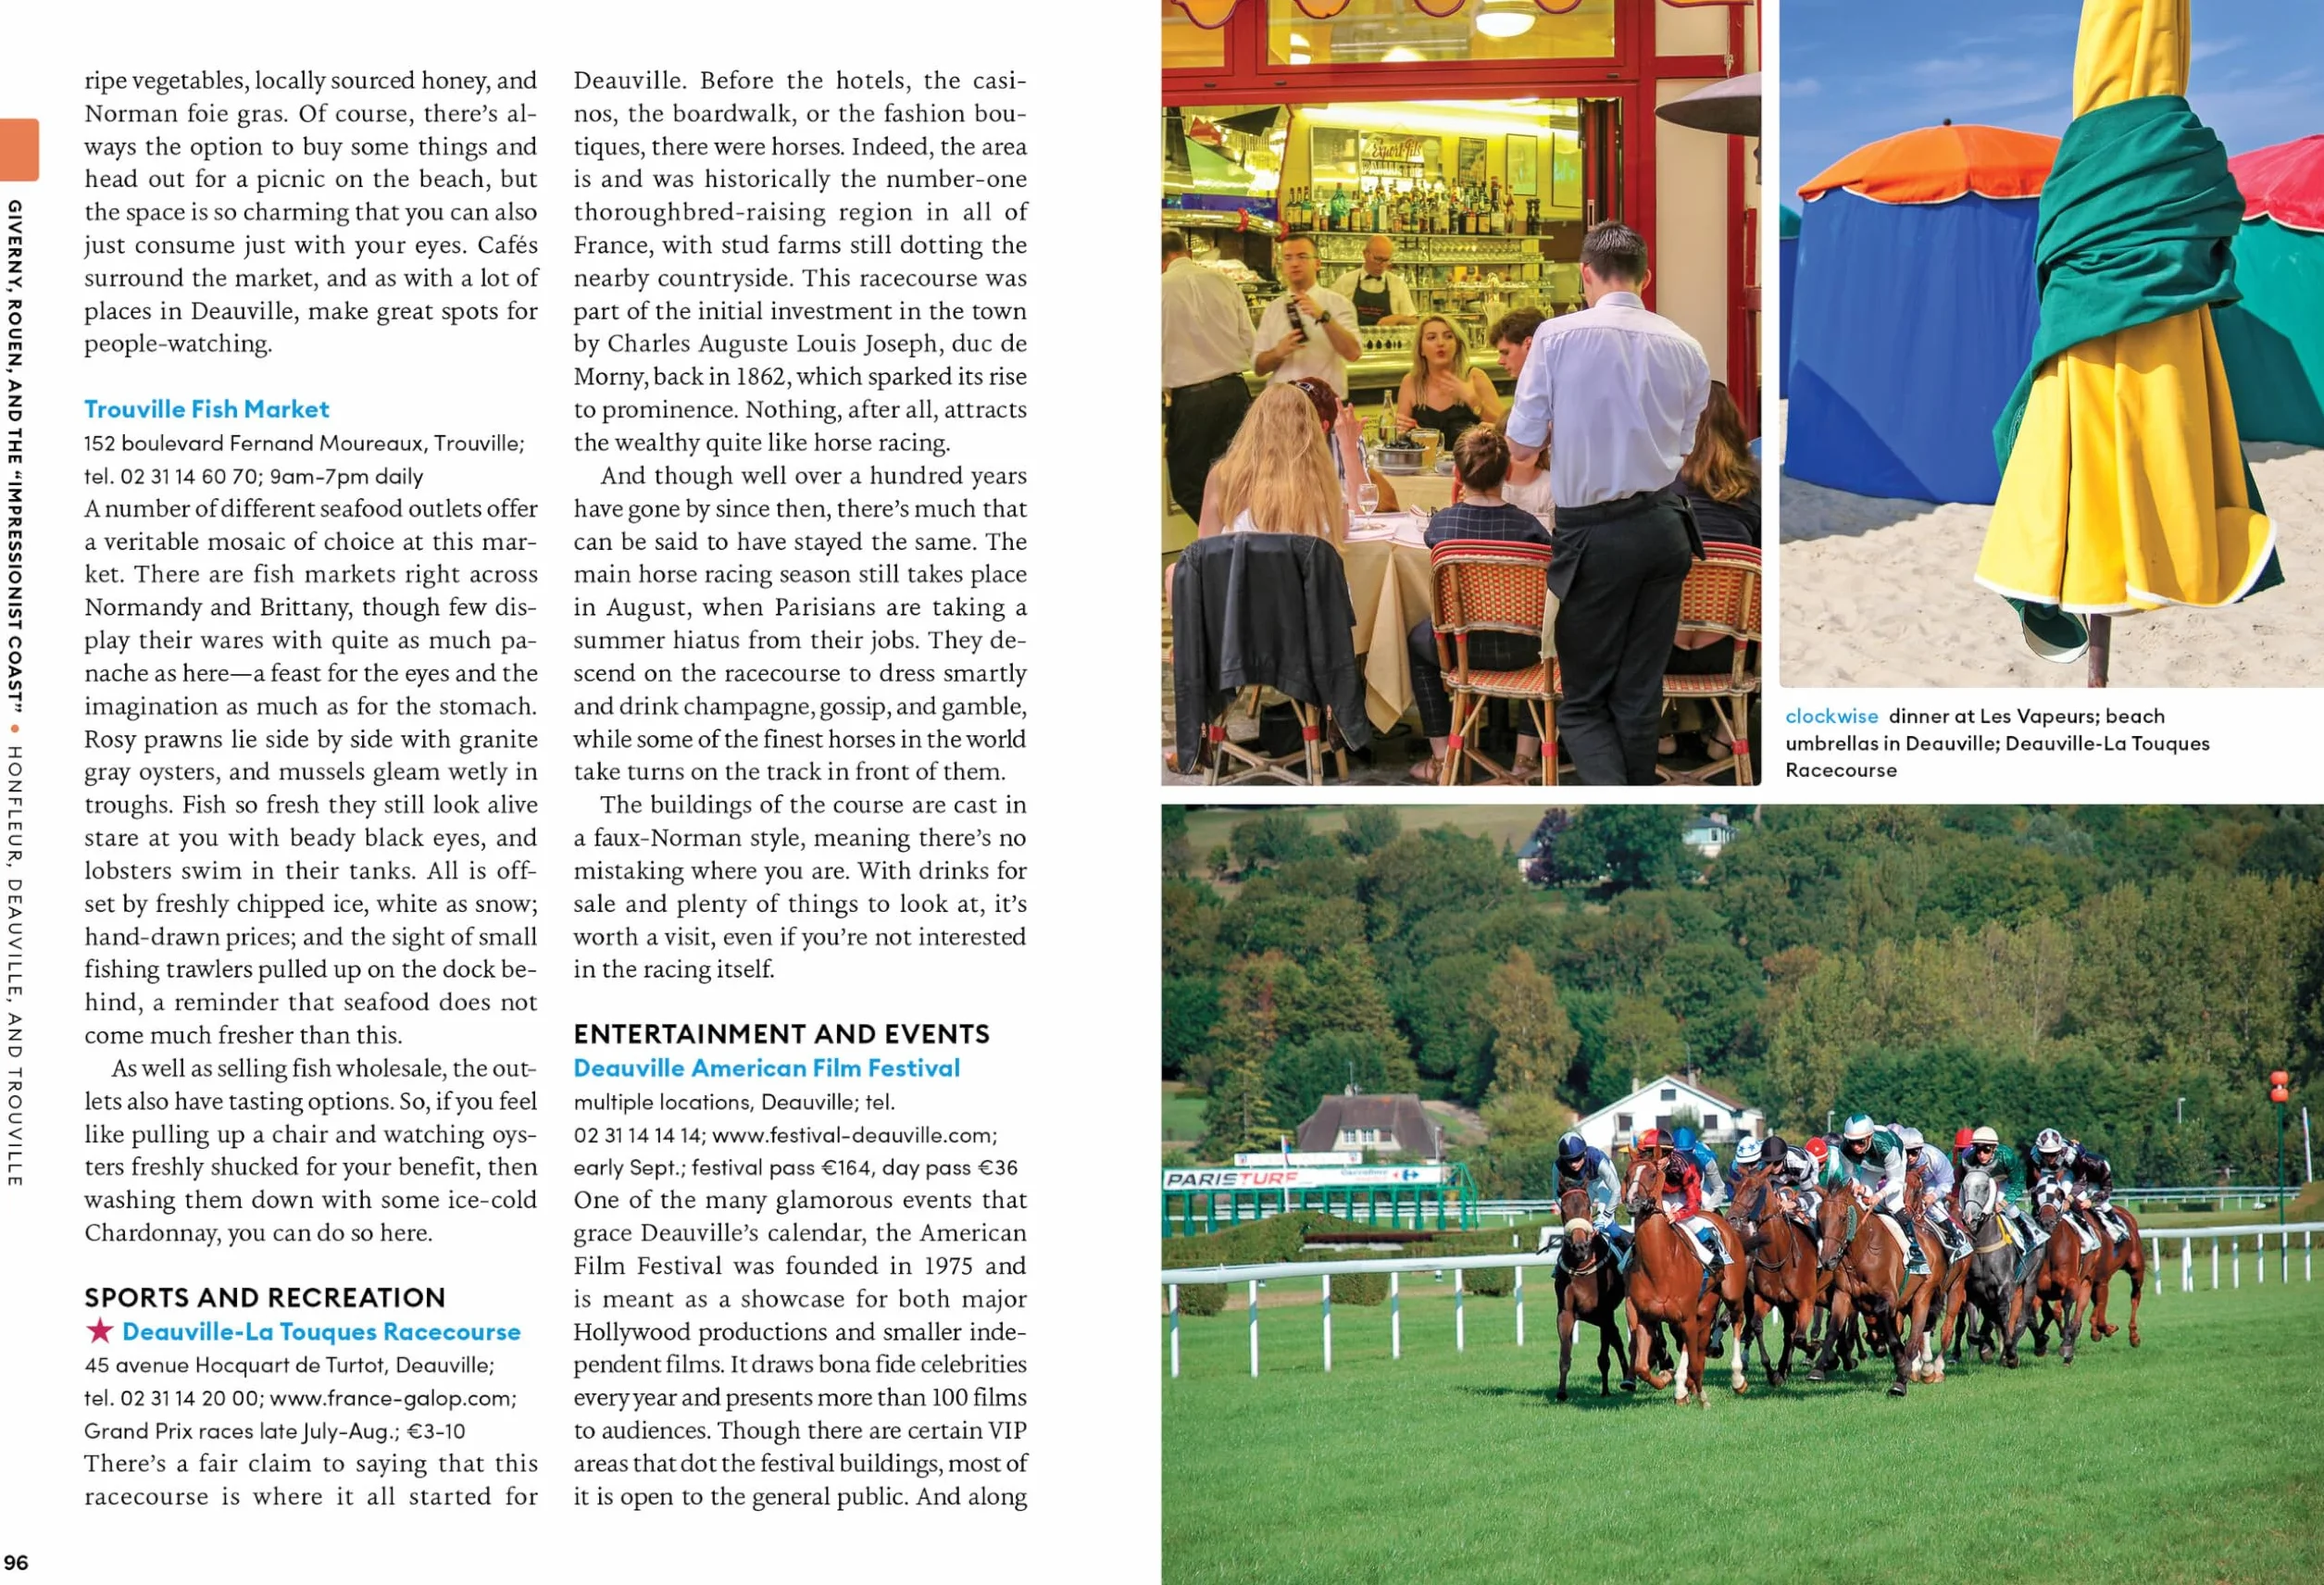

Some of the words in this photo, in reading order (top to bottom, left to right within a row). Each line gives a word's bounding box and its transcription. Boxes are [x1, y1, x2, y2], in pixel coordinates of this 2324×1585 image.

[85, 70, 127, 94] ripe
[132, 70, 249, 95] vegetables,
[256, 70, 327, 94] locally
[331, 70, 415, 89] sourced
[422, 70, 491, 95] honey,
[497, 70, 537, 89] and
[574, 70, 686, 89] Deauville.
[701, 69, 773, 89] Before
[787, 70, 822, 89] the
[837, 70, 911, 94] hotels,
[925, 70, 960, 89] the
[974, 70, 1026, 89] casi-
[575, 202, 826, 227] thoroughbred-raising
[840, 202, 912, 227] region
[928, 202, 948, 220] in
[964, 202, 991, 220] all
[1006, 201, 1030, 220] of
[6, 200, 22, 293] GIVERNY,
[84, 301, 151, 325] places
[161, 301, 181, 319] in
[192, 301, 299, 324] Deauville,
[308, 301, 369, 319] make
[377, 305, 433, 326] great
[442, 305, 498, 325] spots
[507, 300, 538, 319] for
[6, 300, 22, 373] ROUEN,
[8, 379, 22, 421] AND
[84, 398, 185, 418] Trouville
[193, 399, 237, 418] Fish
[245, 399, 330, 418] Market
[8, 428, 22, 464] THE
[85, 436, 115, 451] 152
[122, 434, 223, 451] boulevard
[231, 434, 313, 451] Fernand
[320, 435, 428, 454] Moureaux,
[434, 434, 524, 454] Trouville;
[84, 467, 114, 484] tel.
[121, 468, 144, 484] 02
[152, 468, 168, 484] 31
[176, 468, 195, 484] 14
[203, 468, 226, 484] 60
[233, 468, 263, 487] 70;
[271, 468, 369, 489] 9am-7pm
[376, 467, 423, 489] daily
[8, 470, 22, 630] “IMPRESSIONIST
[8, 636, 22, 712] COAST”
[1786, 707, 1879, 724] clockwise
[1890, 707, 1950, 723] dinner
[1955, 710, 1975, 723] at
[1981, 708, 2011, 723] Les
[2017, 708, 2100, 728] Vapeurs;
[2106, 707, 2165, 723] beach
[1787, 735, 1879, 751] umbrellas
[1884, 735, 1900, 751] in
[1906, 735, 2000, 754] Deauville;
[2006, 735, 2126, 751] Deauville-La
[2131, 736, 2210, 755] Touques
[85, 768, 131, 786] gray
[140, 765, 220, 786] oysters,
[230, 761, 270, 780] and
[280, 761, 365, 780] mussels
[373, 762, 440, 786] gleam
[448, 761, 507, 786] wetly
[517, 762, 538, 780] in
[1787, 762, 1897, 777] Racecourse
[6, 747, 22, 867] HONFLEUR,
[574, 833, 586, 846] a
[594, 827, 742, 846] faux-Norman
[751, 828, 806, 852] style,
[815, 828, 910, 853] meaning
[919, 828, 991, 846] there’s
[1000, 833, 1026, 846] no
[6, 880, 22, 1002] DEAUVILLE,
[574, 959, 595, 978] in
[603, 959, 636, 978] the
[643, 959, 711, 984] racing
[718, 958, 774, 978] itself.
[8, 1013, 22, 1057] AND
[575, 1024, 806, 1044] ENTERTAINMENT
[814, 1024, 875, 1043] AND
[886, 1024, 990, 1044] EVENTS
[575, 1057, 685, 1078] Deauville
[692, 1058, 806, 1077] American
[814, 1057, 861, 1078] Film
[868, 1057, 959, 1078] Festival
[575, 1092, 653, 1115] multiple
[661, 1092, 754, 1113] locations,
[763, 1092, 858, 1113] Deauville;
[866, 1092, 894, 1110] tel.
[8, 1067, 22, 1186] TROUVILLE
[575, 1128, 598, 1142] 02
[606, 1128, 621, 1142] 31
[629, 1128, 649, 1142] 14
[656, 1128, 675, 1142] 14
[681, 1128, 706, 1145] 14;
[712, 1126, 996, 1145] www.festival-deauville.com;
[574, 1158, 624, 1180] early
[631, 1159, 685, 1180] Sept.;
[692, 1158, 762, 1176] festival
[770, 1164, 815, 1180] pass
[821, 1160, 875, 1178] €164,
[882, 1158, 919, 1180] day
[927, 1164, 970, 1180] pass
[978, 1160, 1018, 1176] €36
[1167, 1171, 1299, 1187] PARISTURF
[84, 1190, 176, 1215] washing
[185, 1190, 243, 1208] them
[252, 1190, 314, 1208] down
[322, 1189, 372, 1208] with
[381, 1195, 439, 1208] some
[448, 1190, 537, 1208] ice-cold
[574, 1229, 631, 1248] grace
[642, 1222, 758, 1242] Deauville’s
[768, 1222, 866, 1246] calendar,
[877, 1222, 911, 1242] the
[919, 1223, 1027, 1242] American
[85, 1288, 189, 1307] SPORTS
[197, 1288, 258, 1307] AND
[269, 1288, 444, 1307] RECREATION
[123, 1321, 273, 1341] Deauville-La
[280, 1322, 377, 1346] Touques
[384, 1322, 521, 1341] Racecourse
[574, 1321, 691, 1346] Hollywood
[699, 1322, 827, 1346] productions
[836, 1321, 875, 1341] and
[883, 1321, 962, 1341] smaller
[970, 1321, 1026, 1341] inde-
[85, 1357, 108, 1373] 45
[117, 1361, 189, 1373] avenue
[196, 1356, 290, 1378] Hocquart
[295, 1355, 320, 1373] de
[326, 1356, 388, 1376] Turtot,
[397, 1355, 494, 1376] Deauville;
[84, 1389, 114, 1406] tel.
[121, 1391, 144, 1406] 02
[151, 1391, 168, 1406] 31
[176, 1391, 195, 1406] 14
[203, 1391, 225, 1406] 20
[232, 1391, 264, 1408] 00;
[269, 1389, 516, 1411] www.france-galop.com;
[85, 1422, 148, 1439] Grand
[156, 1422, 193, 1439] Prix
[200, 1428, 253, 1439] races
[261, 1423, 297, 1440] late
[301, 1423, 399, 1445] July-Aug.;
[407, 1423, 465, 1439] €3-10
[4, 1554, 29, 1570] 96
